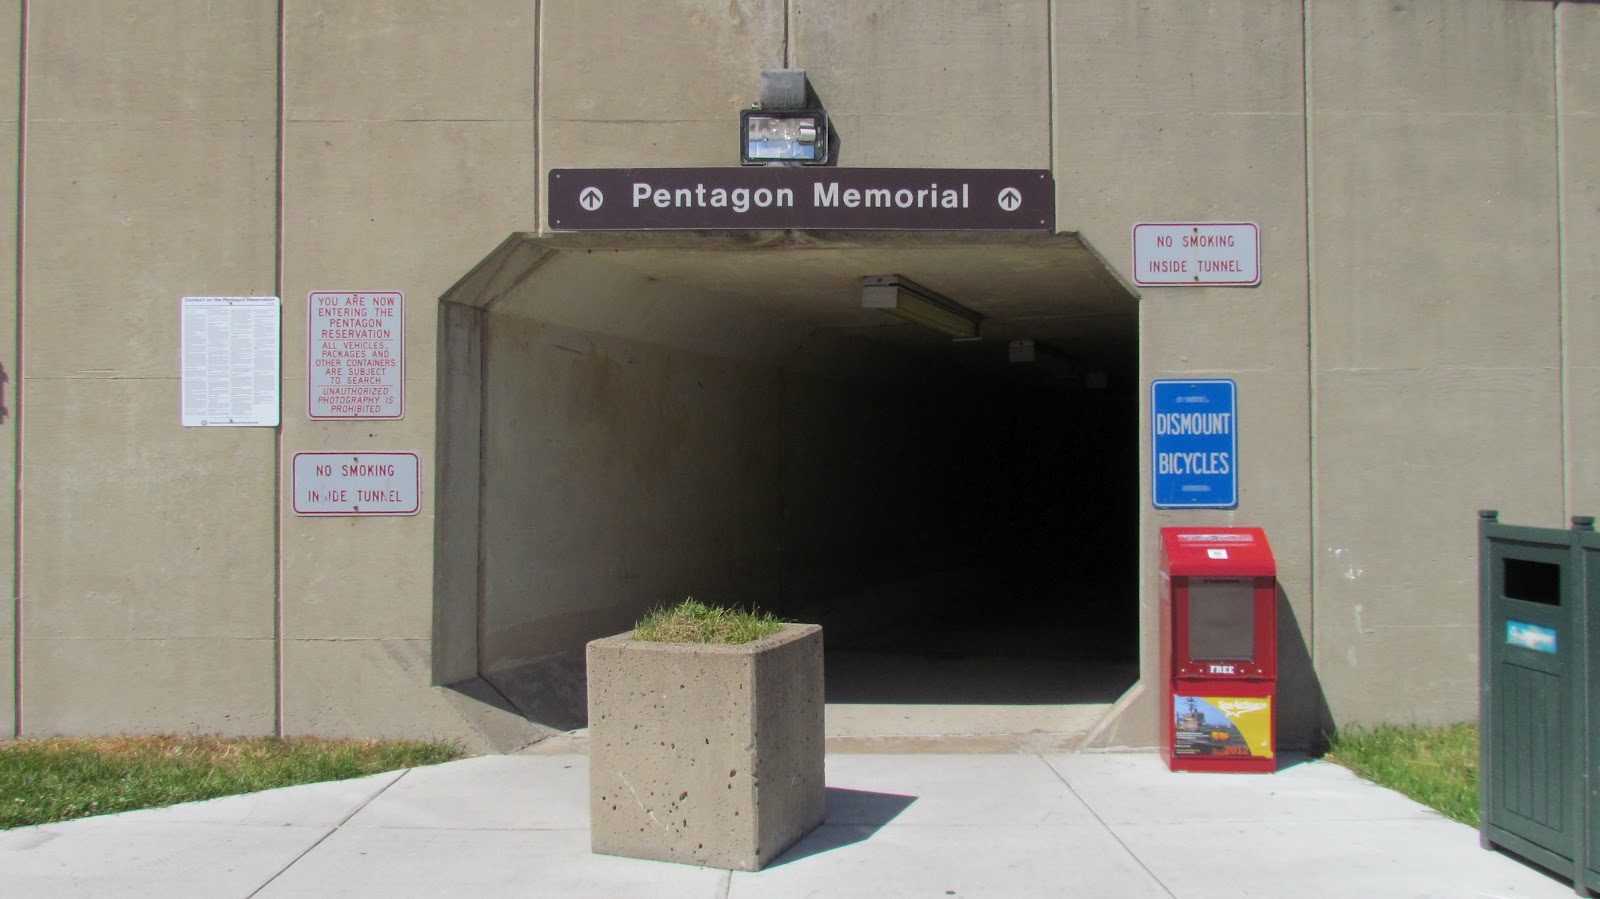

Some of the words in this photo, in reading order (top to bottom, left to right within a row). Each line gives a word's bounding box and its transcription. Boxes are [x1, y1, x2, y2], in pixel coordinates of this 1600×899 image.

[633, 183, 793, 213] Pentagon
[813, 183, 969, 209] Memorial
[1157, 236, 1172, 247] NO
[1182, 236, 1234, 247] SMOKING
[1149, 261, 1187, 272] INSIDE
[1198, 261, 1242, 272] TUNNEL
[319, 298, 338, 306] YOU
[345, 297, 365, 306] ARE
[373, 297, 394, 306] NOW
[319, 308, 367, 317] ENTERING
[375, 308, 393, 317] THE
[330, 319, 382, 327] PENTAGON
[322, 330, 390, 338] RESERVATION
[316, 359, 341, 367] OTHER
[347, 359, 395, 367] CONTAINERS
[326, 368, 343, 376] ARE
[349, 368, 386, 376] SUBJECT
[1157, 413, 1230, 435] DISMOUNT
[1159, 452, 1229, 474] BICYCLES
[316, 465, 331, 476] NO
[342, 465, 394, 476] SMOKING
[309, 490, 347, 502] INIDE
[1224, 746, 1248, 755] 2012
